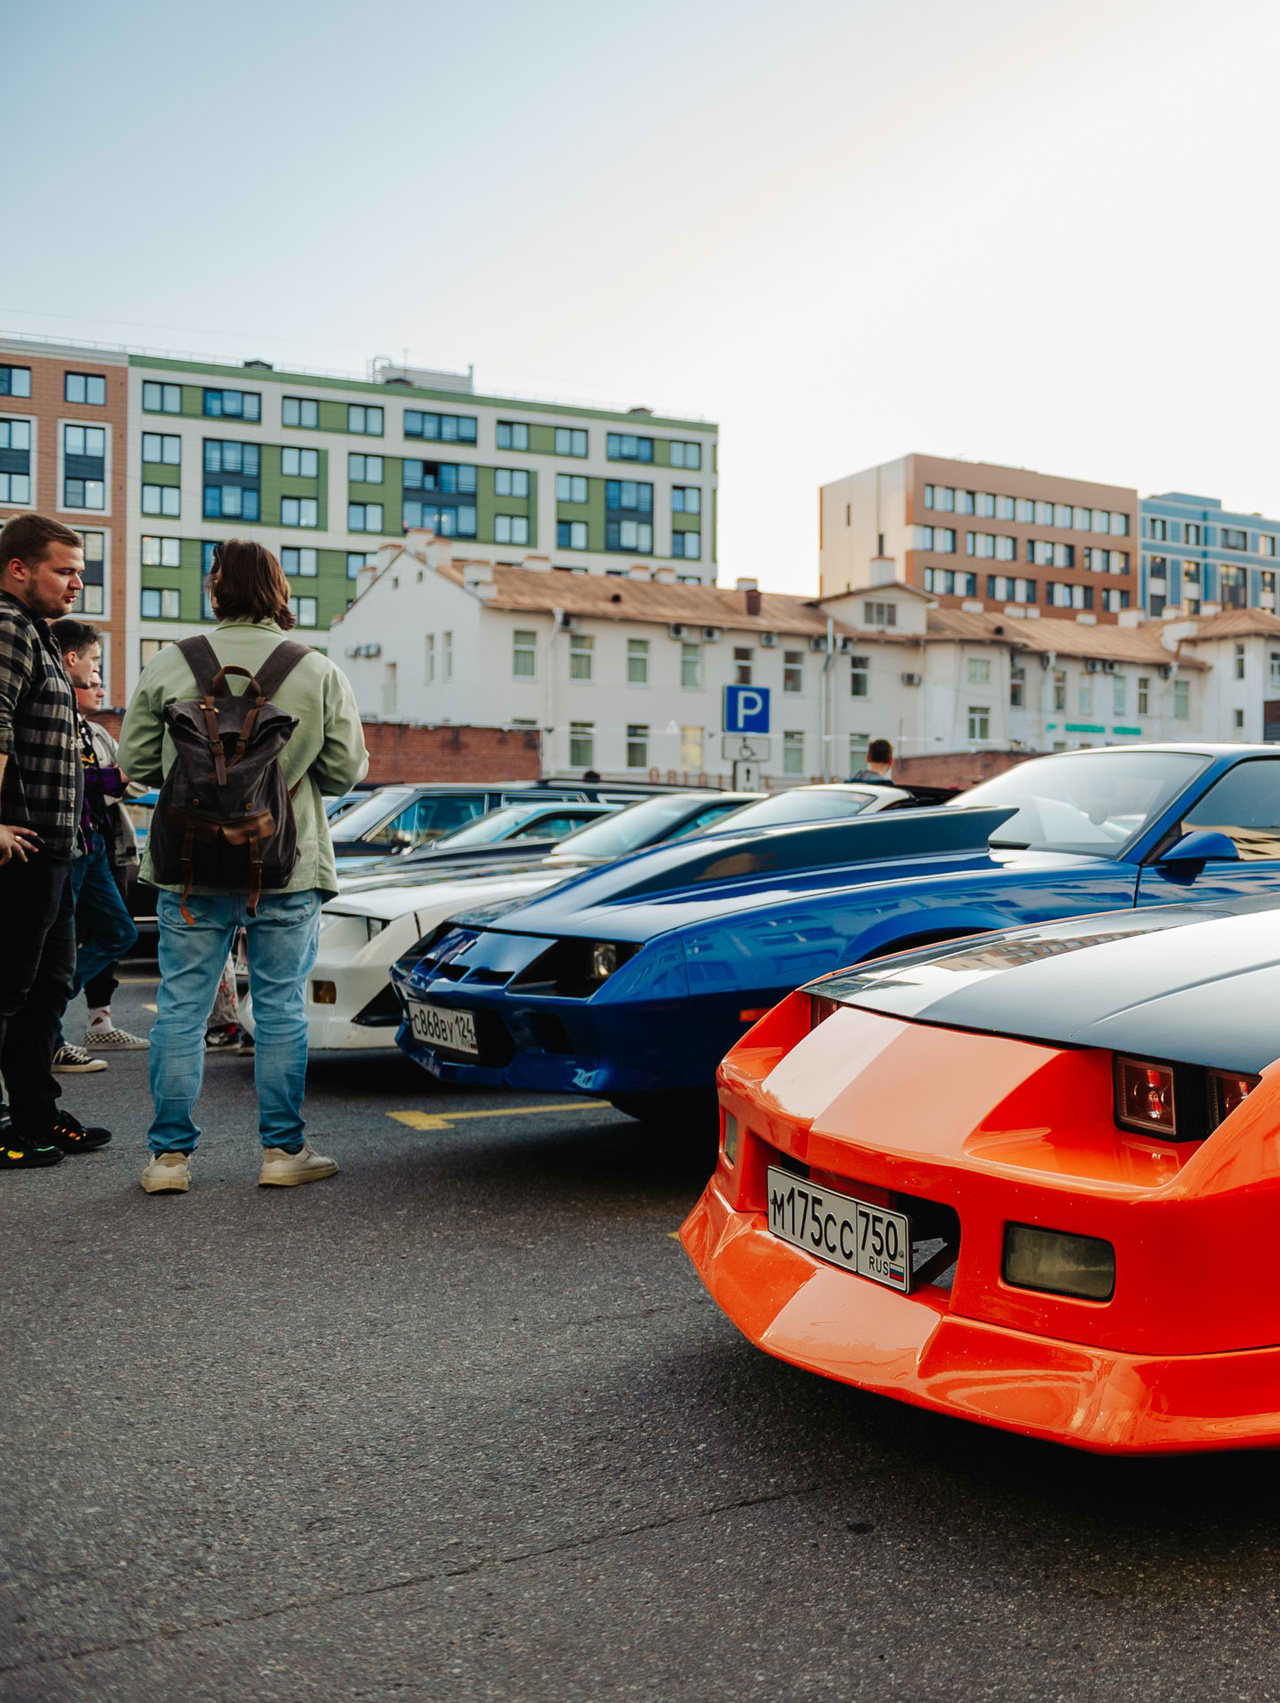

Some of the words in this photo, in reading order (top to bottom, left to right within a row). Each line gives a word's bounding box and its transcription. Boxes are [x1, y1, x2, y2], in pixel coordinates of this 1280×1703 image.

[737, 690, 763, 729] P
[455, 1015, 474, 1040] 124
[771, 1186, 854, 1260] M175CC
[859, 1210, 898, 1260] 750
[868, 1256, 889, 1276] RUS
